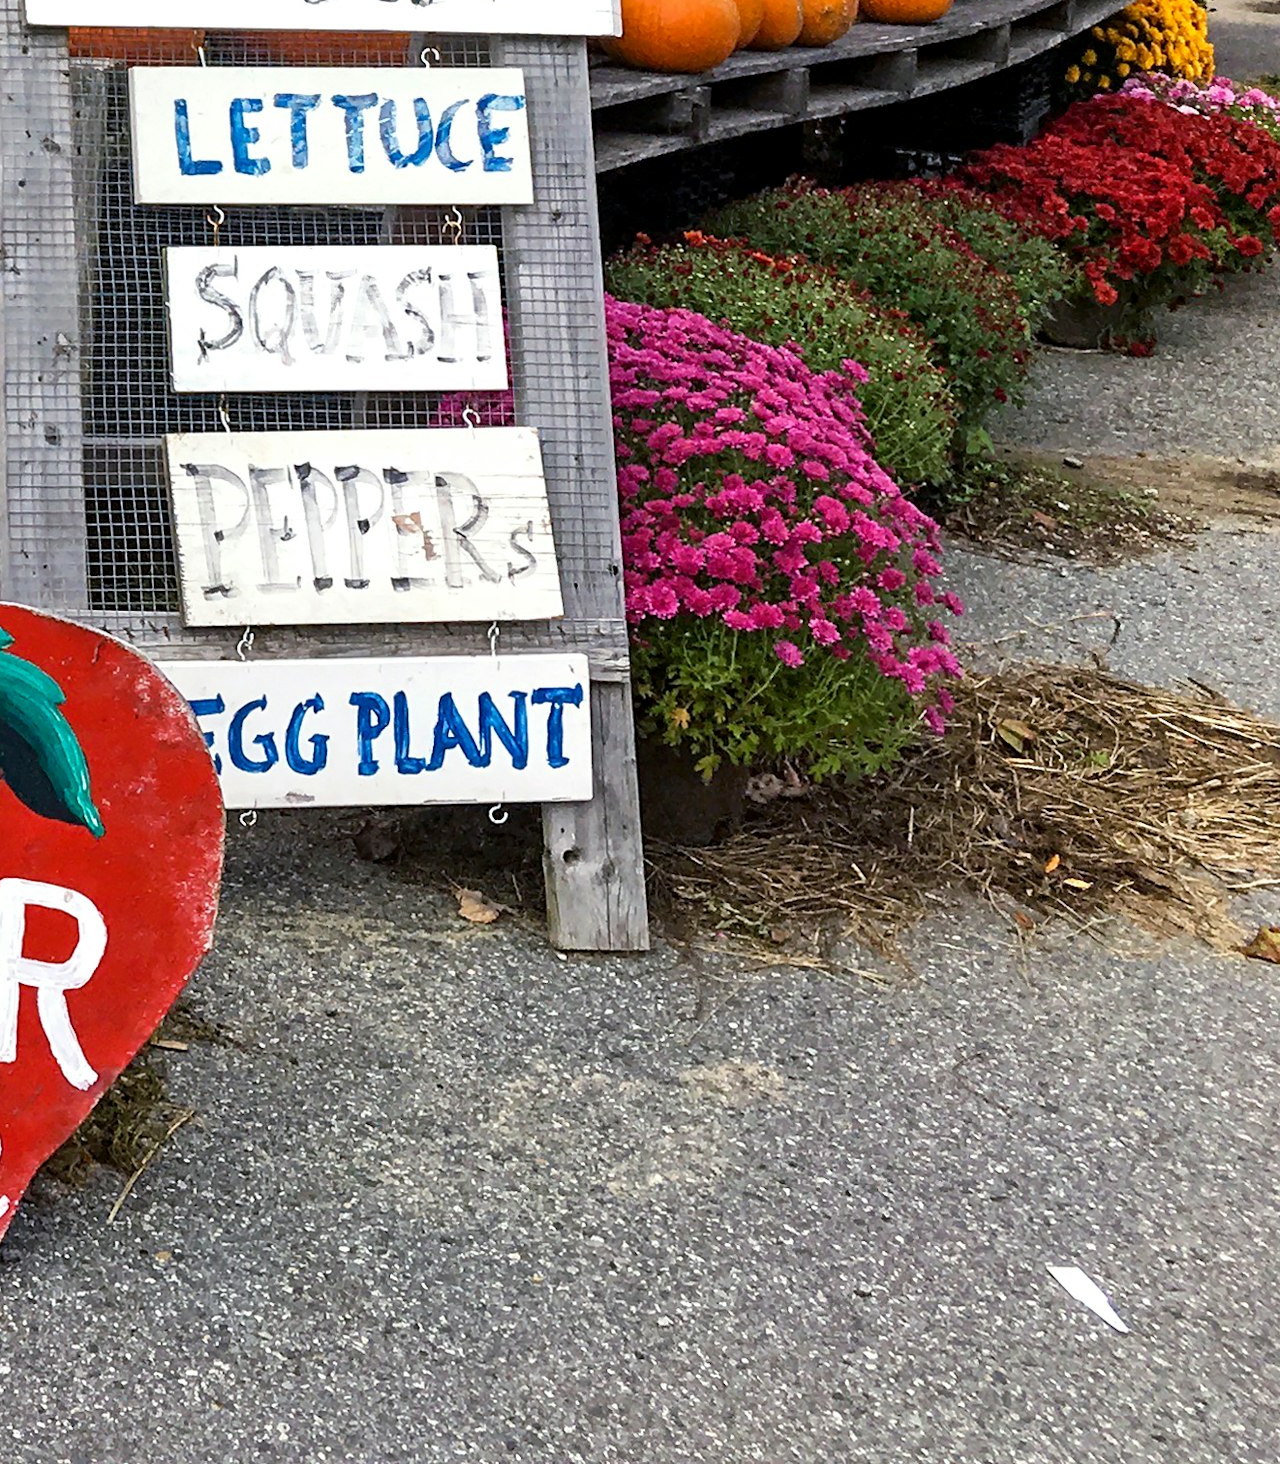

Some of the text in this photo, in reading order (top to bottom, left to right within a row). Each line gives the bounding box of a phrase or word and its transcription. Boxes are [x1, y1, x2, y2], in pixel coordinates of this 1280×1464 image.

[172, 92, 526, 177] LETTUCE
[196, 254, 495, 366] SQUASH
[348, 682, 583, 776] PLANT
